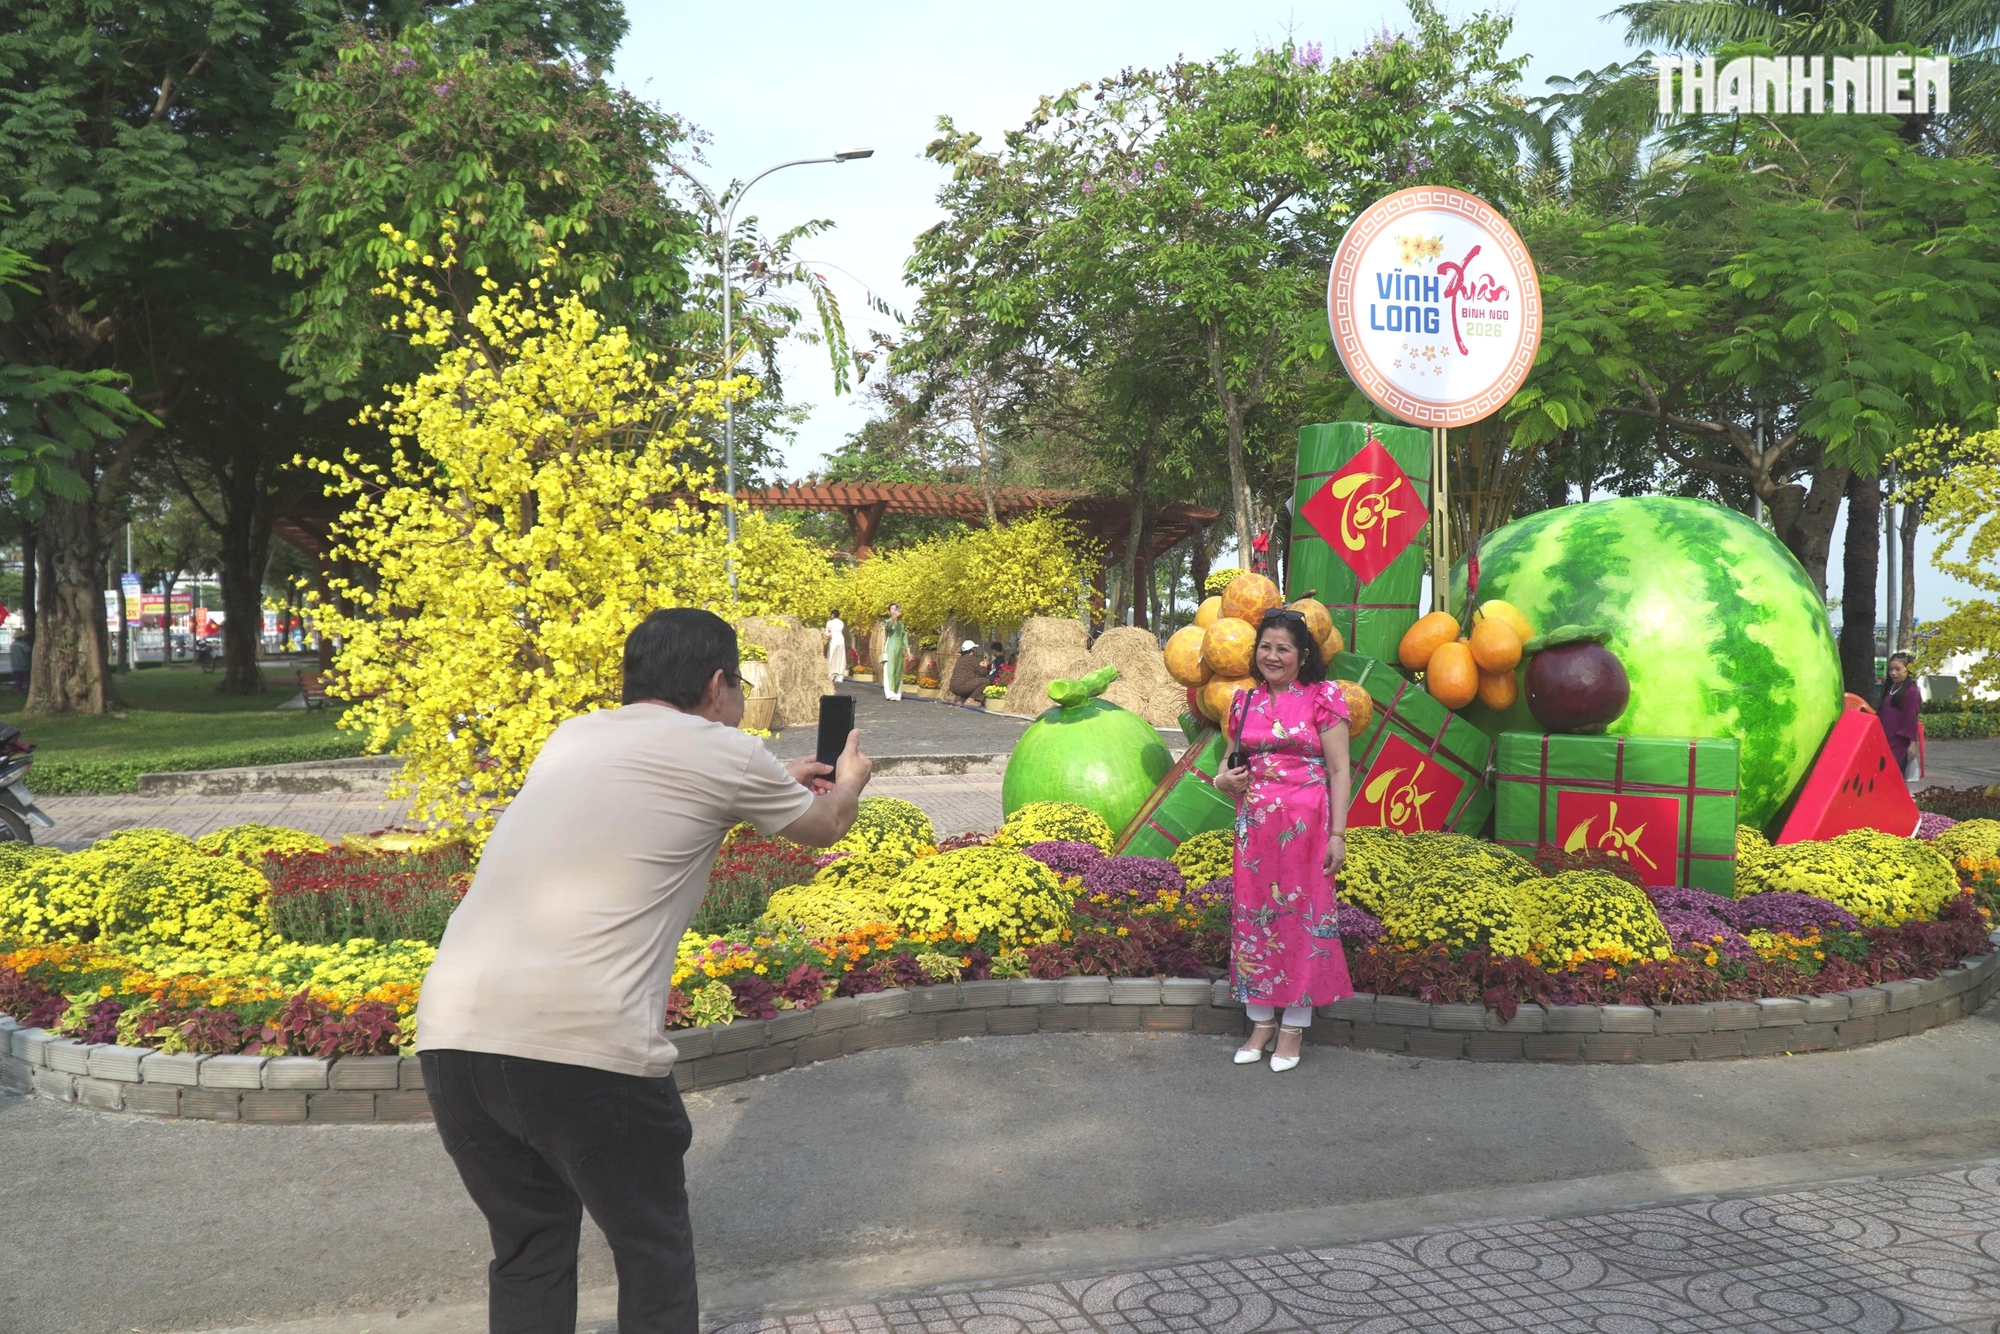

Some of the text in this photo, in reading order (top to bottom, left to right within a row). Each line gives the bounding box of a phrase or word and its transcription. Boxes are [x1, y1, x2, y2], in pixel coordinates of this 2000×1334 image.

[1376, 268, 1439, 302] VĨNH
[1437, 245, 1510, 356] Xuân
[1370, 304, 1440, 334] LONG
[1462, 306, 1509, 323] BÍNH NGỌ
[1466, 322, 1502, 337] 2026
[1332, 472, 1407, 551] Tết
